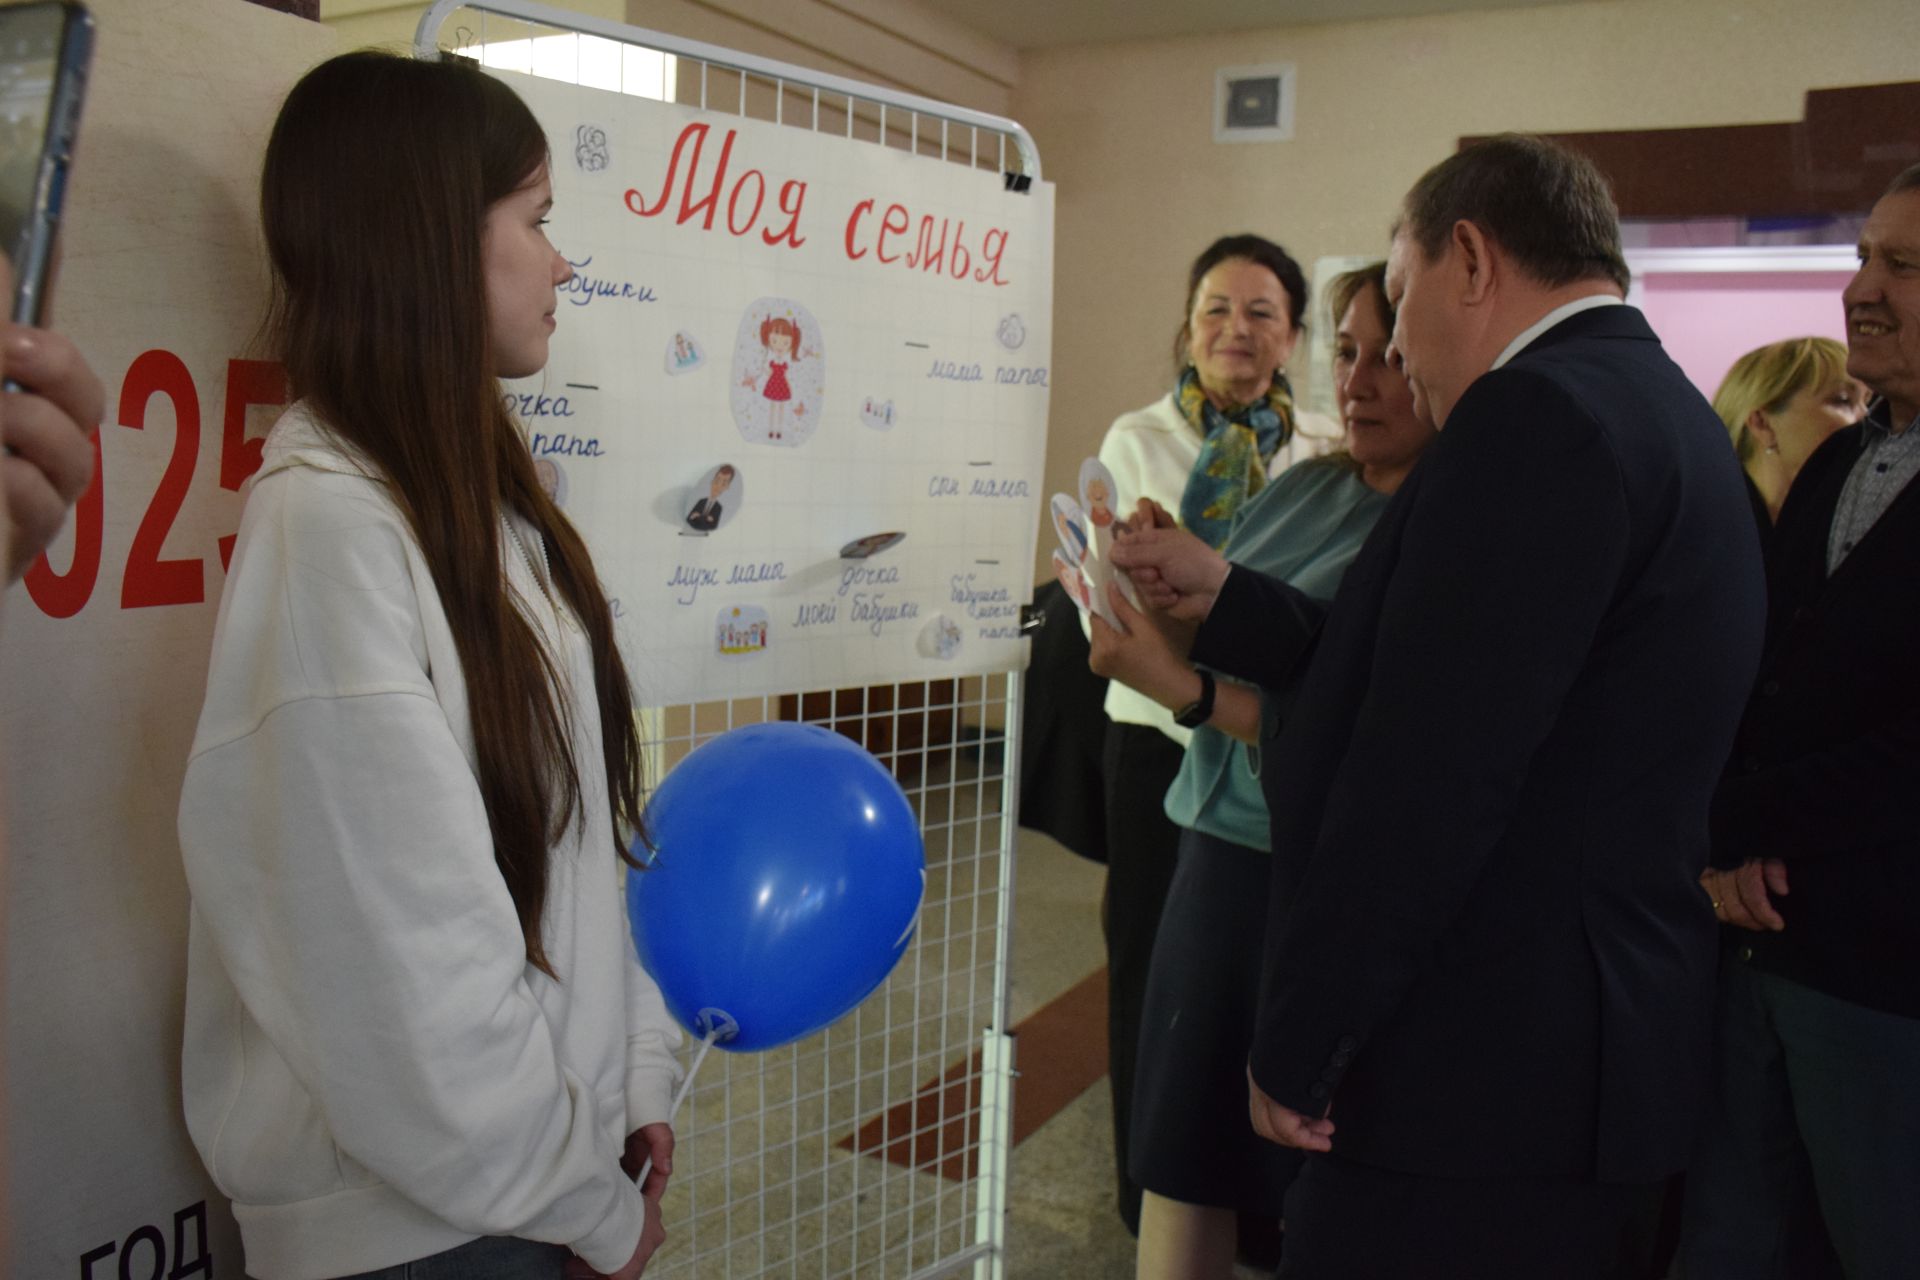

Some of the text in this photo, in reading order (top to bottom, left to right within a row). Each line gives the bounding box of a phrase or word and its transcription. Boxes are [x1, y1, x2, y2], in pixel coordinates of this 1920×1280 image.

[623, 122, 1010, 286] Моя семья
[557, 250, 658, 306] бушки
[927, 360, 1049, 388] мама папы
[503, 393, 574, 417] очка
[532, 432, 606, 457] папы
[928, 475, 1029, 498] сын мамы
[667, 561, 787, 605] муж мамы
[838, 565, 901, 596] дочка
[950, 573, 1010, 617] бабушка
[792, 594, 920, 637] моей бабушки
[80, 1199, 213, 1280] ГОД
